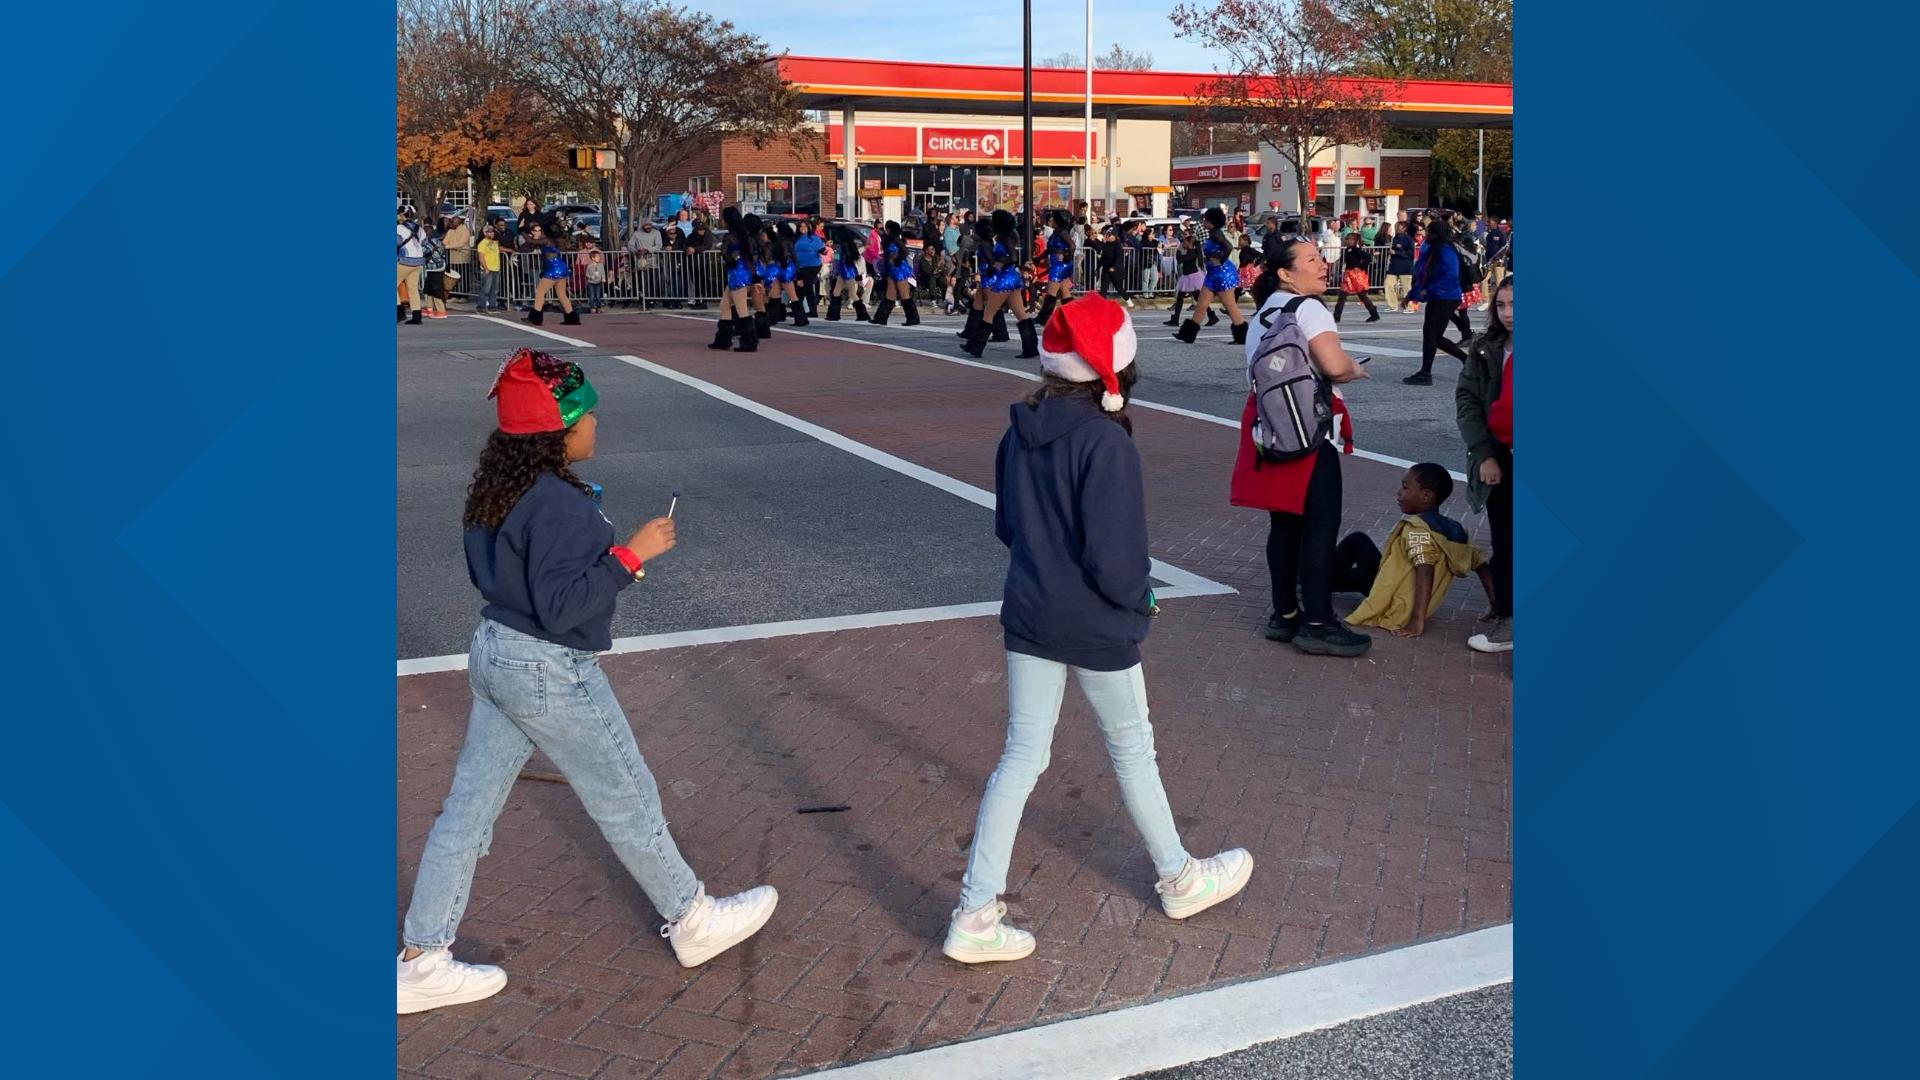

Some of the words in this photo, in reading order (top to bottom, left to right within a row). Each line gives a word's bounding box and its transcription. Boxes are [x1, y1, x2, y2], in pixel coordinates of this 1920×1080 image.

[928, 136, 979, 151] CIRCLE
[983, 136, 999, 155] K
[1344, 169, 1361, 177] ASH
